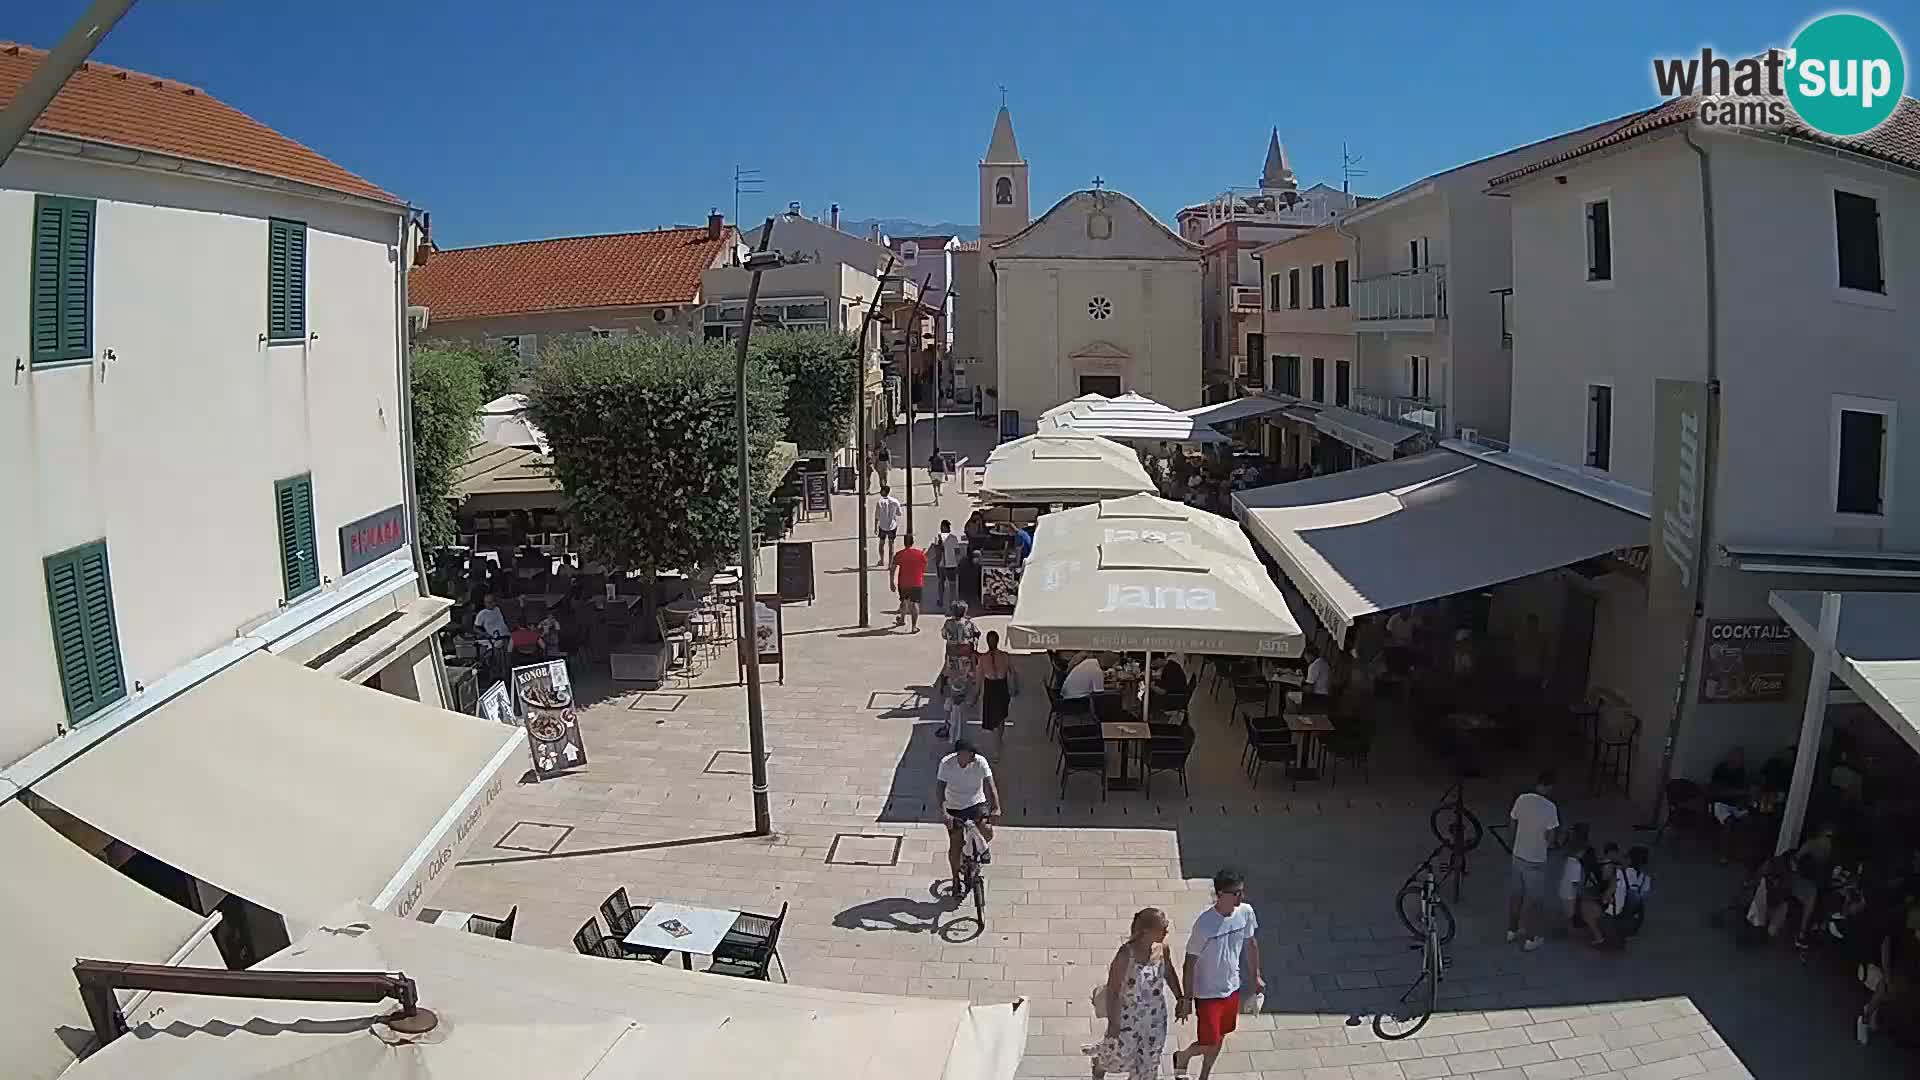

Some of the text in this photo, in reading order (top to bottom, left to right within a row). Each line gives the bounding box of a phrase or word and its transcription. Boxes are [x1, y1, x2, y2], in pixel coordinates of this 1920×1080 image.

[1711, 624, 1792, 639] COCKTAILS
[518, 667, 551, 685] KONOB
[429, 846, 453, 881] Cakes
